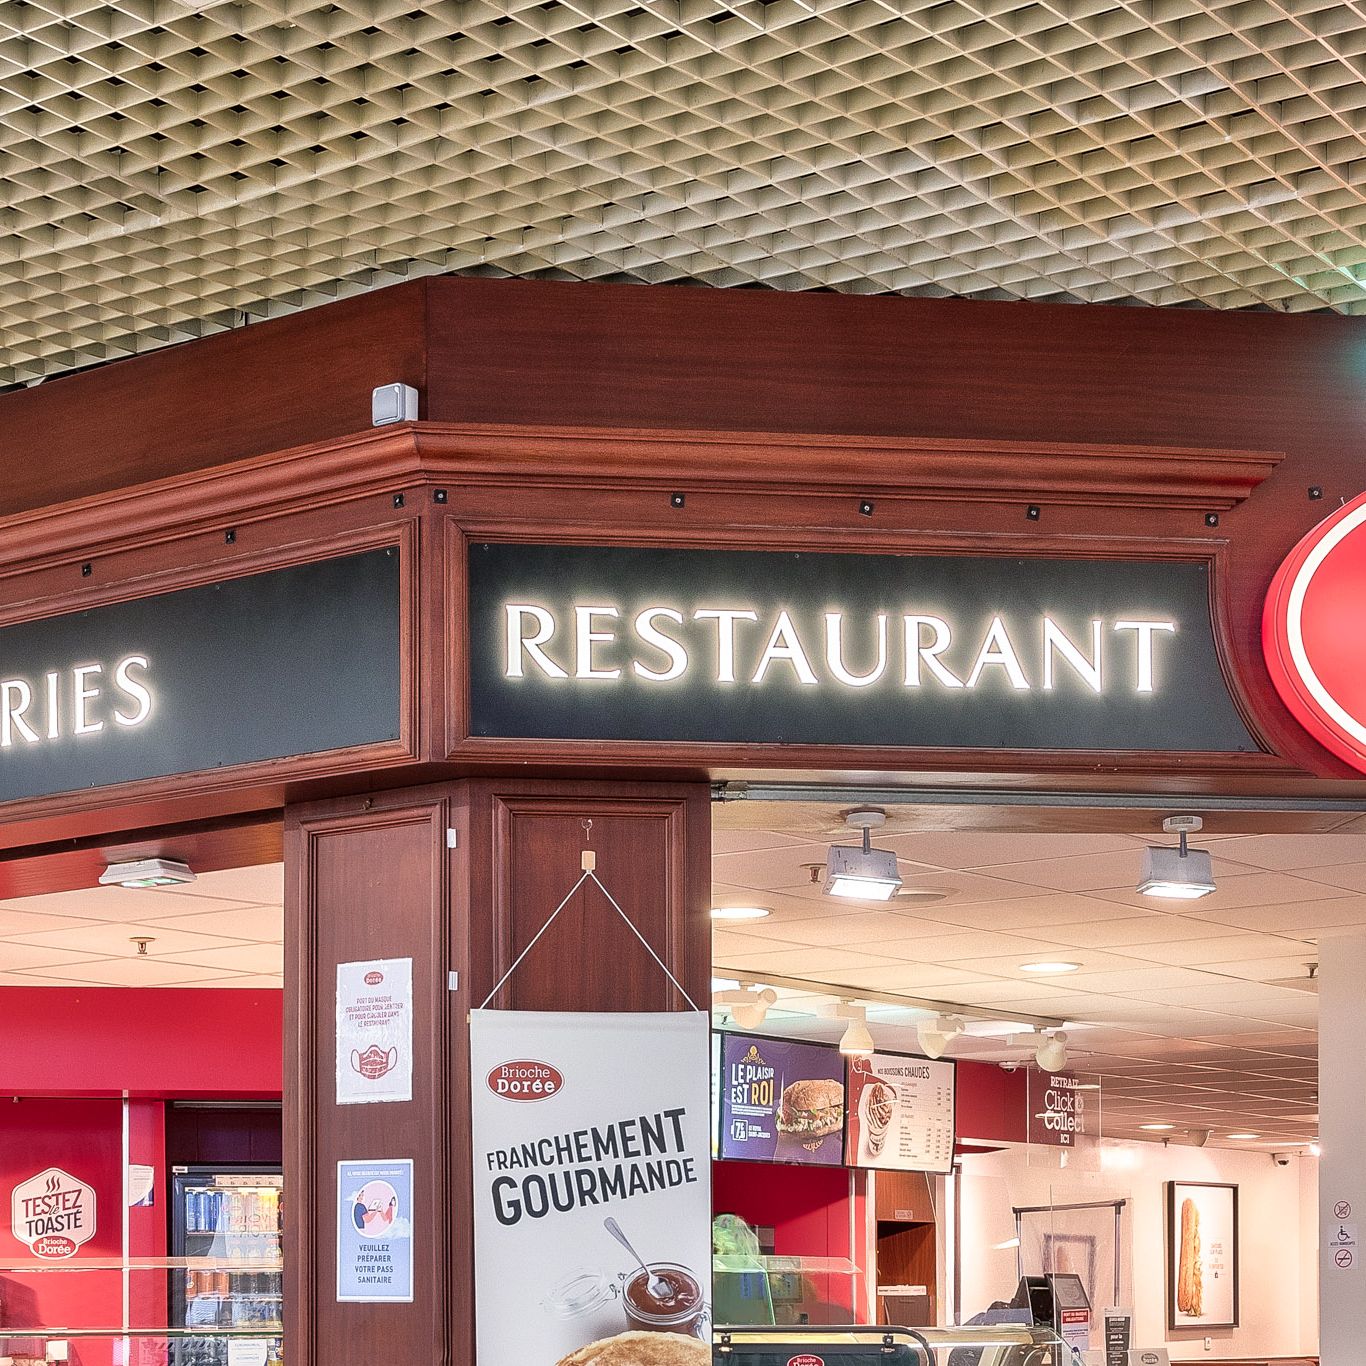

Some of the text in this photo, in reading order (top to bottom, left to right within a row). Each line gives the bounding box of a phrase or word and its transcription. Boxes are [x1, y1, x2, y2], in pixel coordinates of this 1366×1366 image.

[506, 604, 1175, 695] RESTAURANT
[501, 1065, 551, 1079] Brioche
[731, 1063, 775, 1085] LE PLAISIR
[885, 1067, 904, 1077] BOISSONS
[904, 1066, 931, 1080] CHAUDES
[1050, 1075, 1080, 1089] RETRAIT
[731, 1079, 774, 1106] EST ROI
[1044, 1089, 1075, 1112] Click
[1044, 1109, 1085, 1133] Collect
[486, 1107, 687, 1171] FRANCHEMENT
[1060, 1133, 1070, 1144] ICI
[490, 1157, 698, 1226] GOURMANDE
[21, 1188, 83, 1219] TESTEZ
[25, 1208, 84, 1238] TOASTÉ
[37, 1241, 72, 1256] Dorée
[42, 1237, 68, 1246] Brioche
[358, 1243, 390, 1253] VEUILLEZ
[357, 1252, 392, 1263] PRÉPARER
[354, 1264, 394, 1274] VOTRE PASS
[357, 1275, 393, 1285] SANITAIRE
